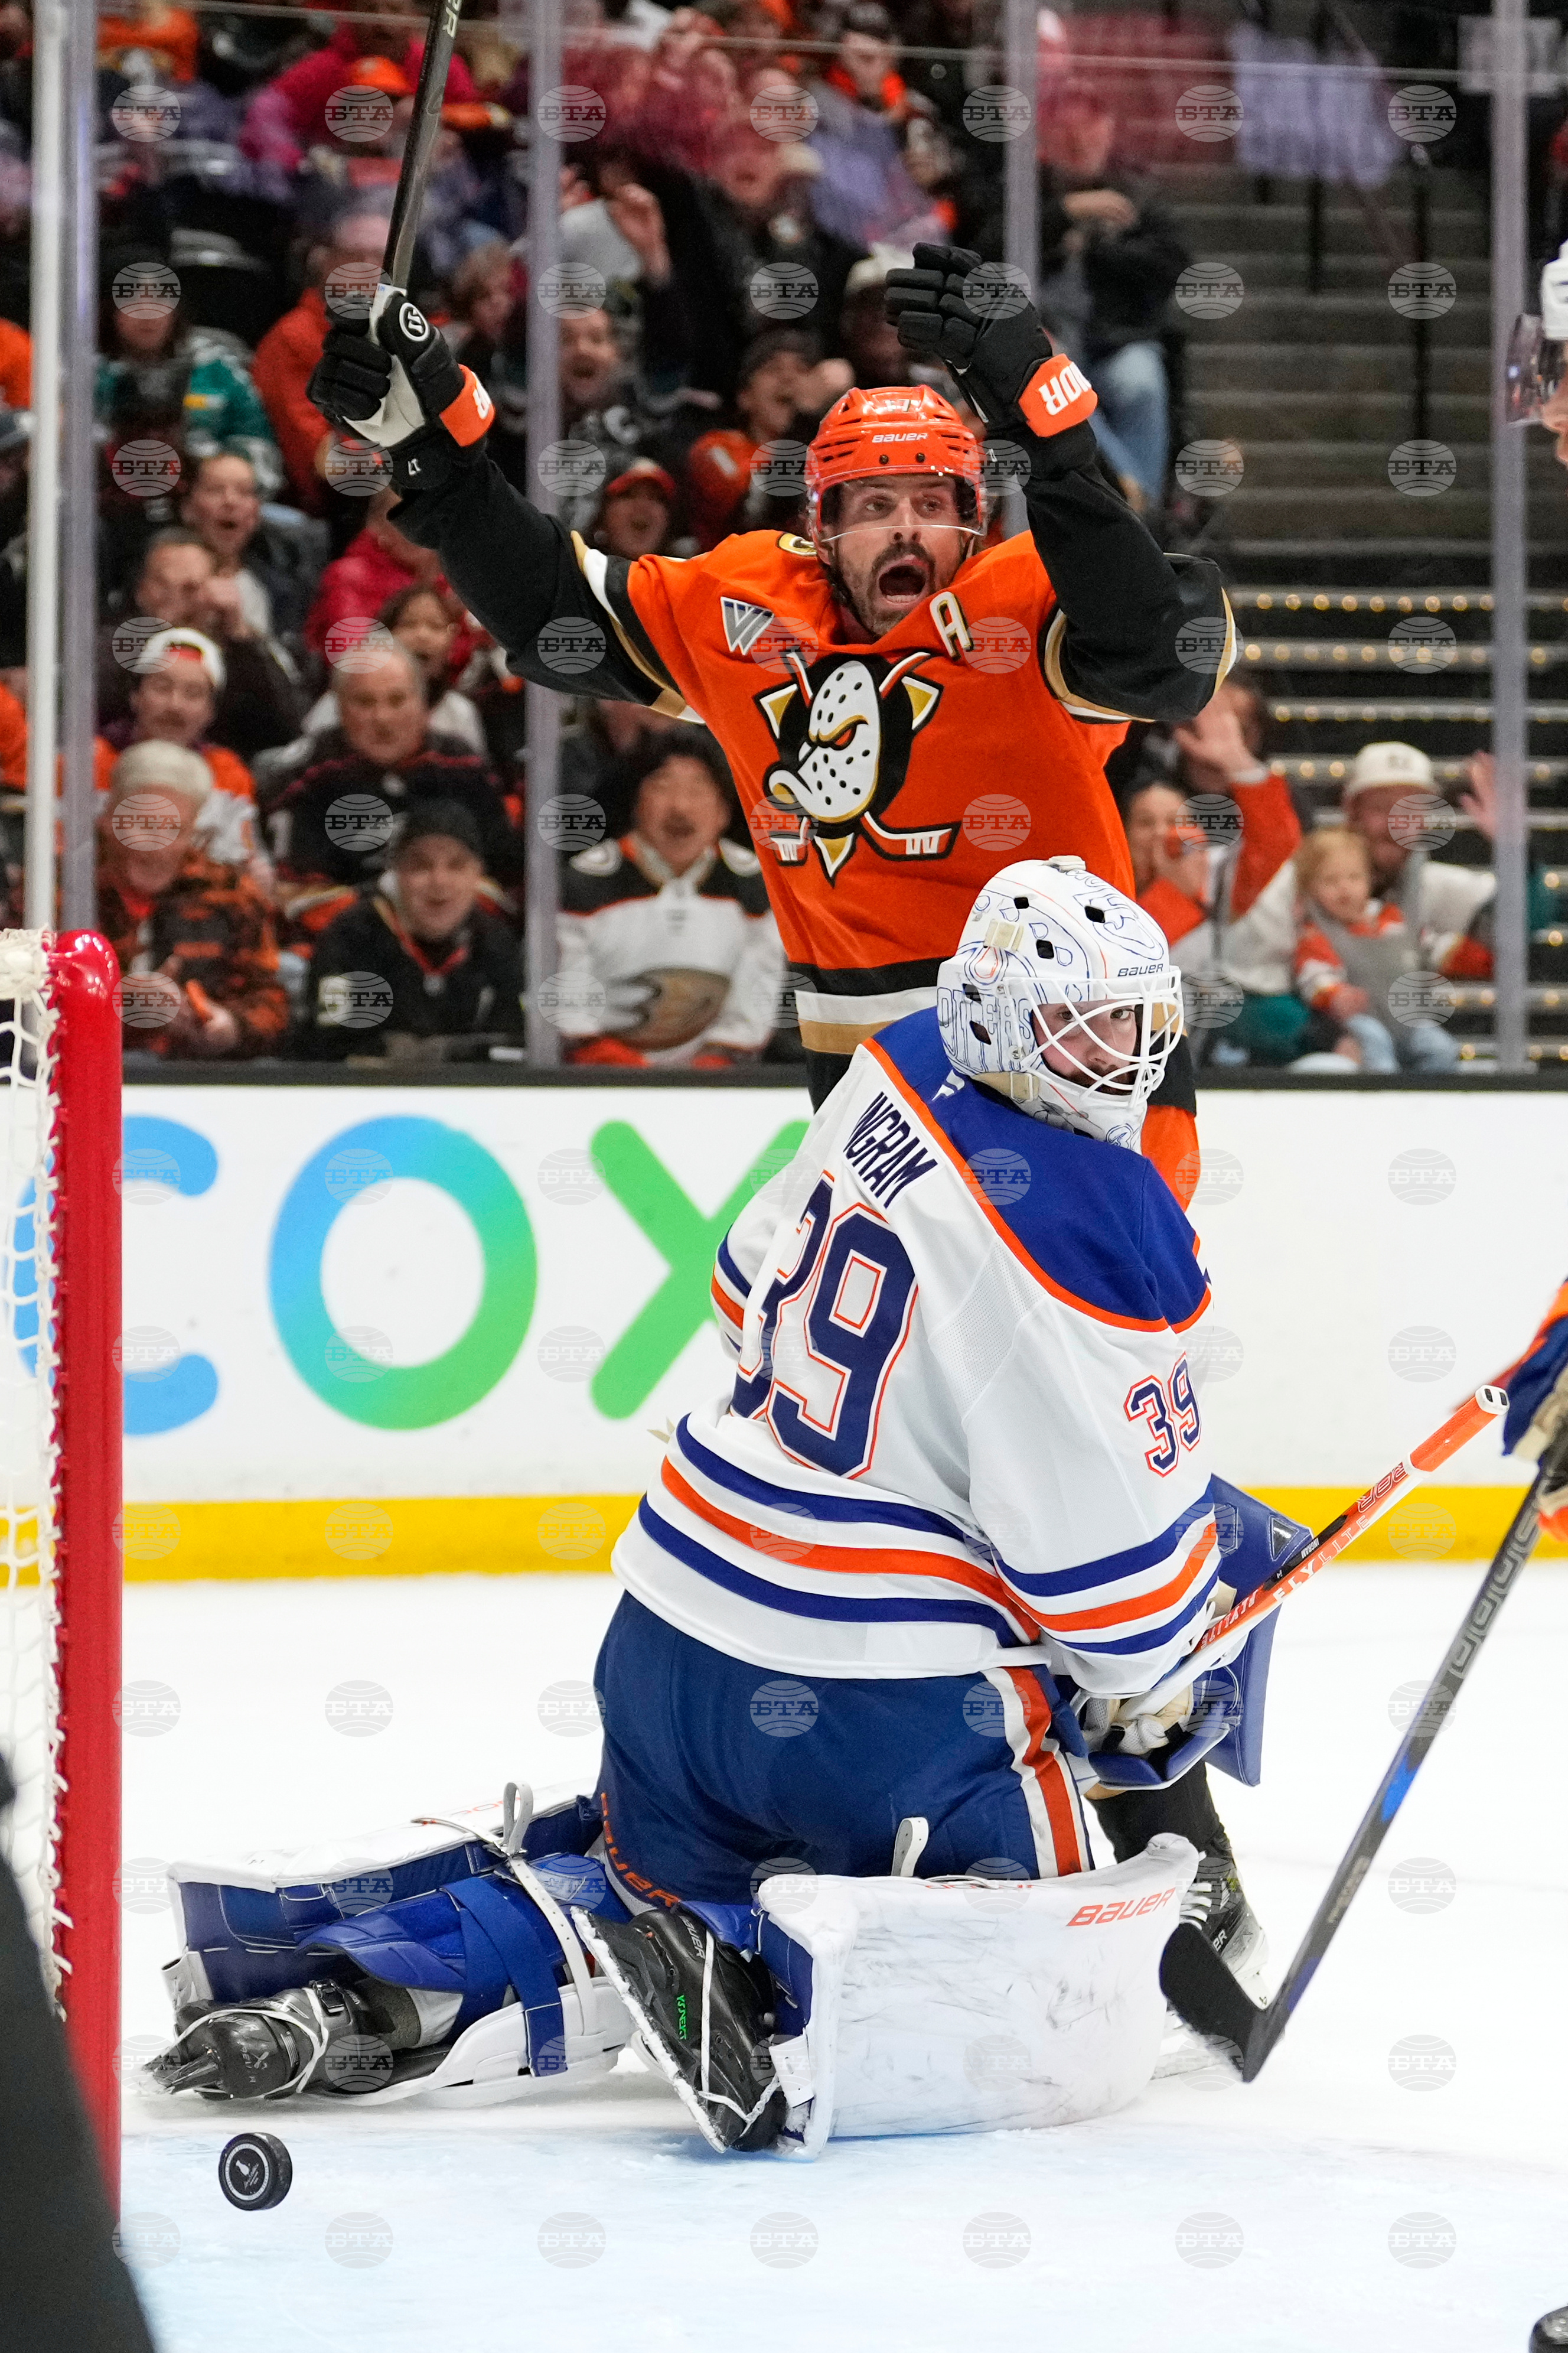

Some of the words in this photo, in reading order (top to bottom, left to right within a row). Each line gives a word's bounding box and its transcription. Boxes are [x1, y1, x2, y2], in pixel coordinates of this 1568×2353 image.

[872, 432, 928, 443] BAUER
[930, 591, 973, 661] A
[1117, 963, 1164, 978] BAUER
[1123, 1350, 1202, 1478] 39
[1066, 1887, 1176, 1926] BAUER
